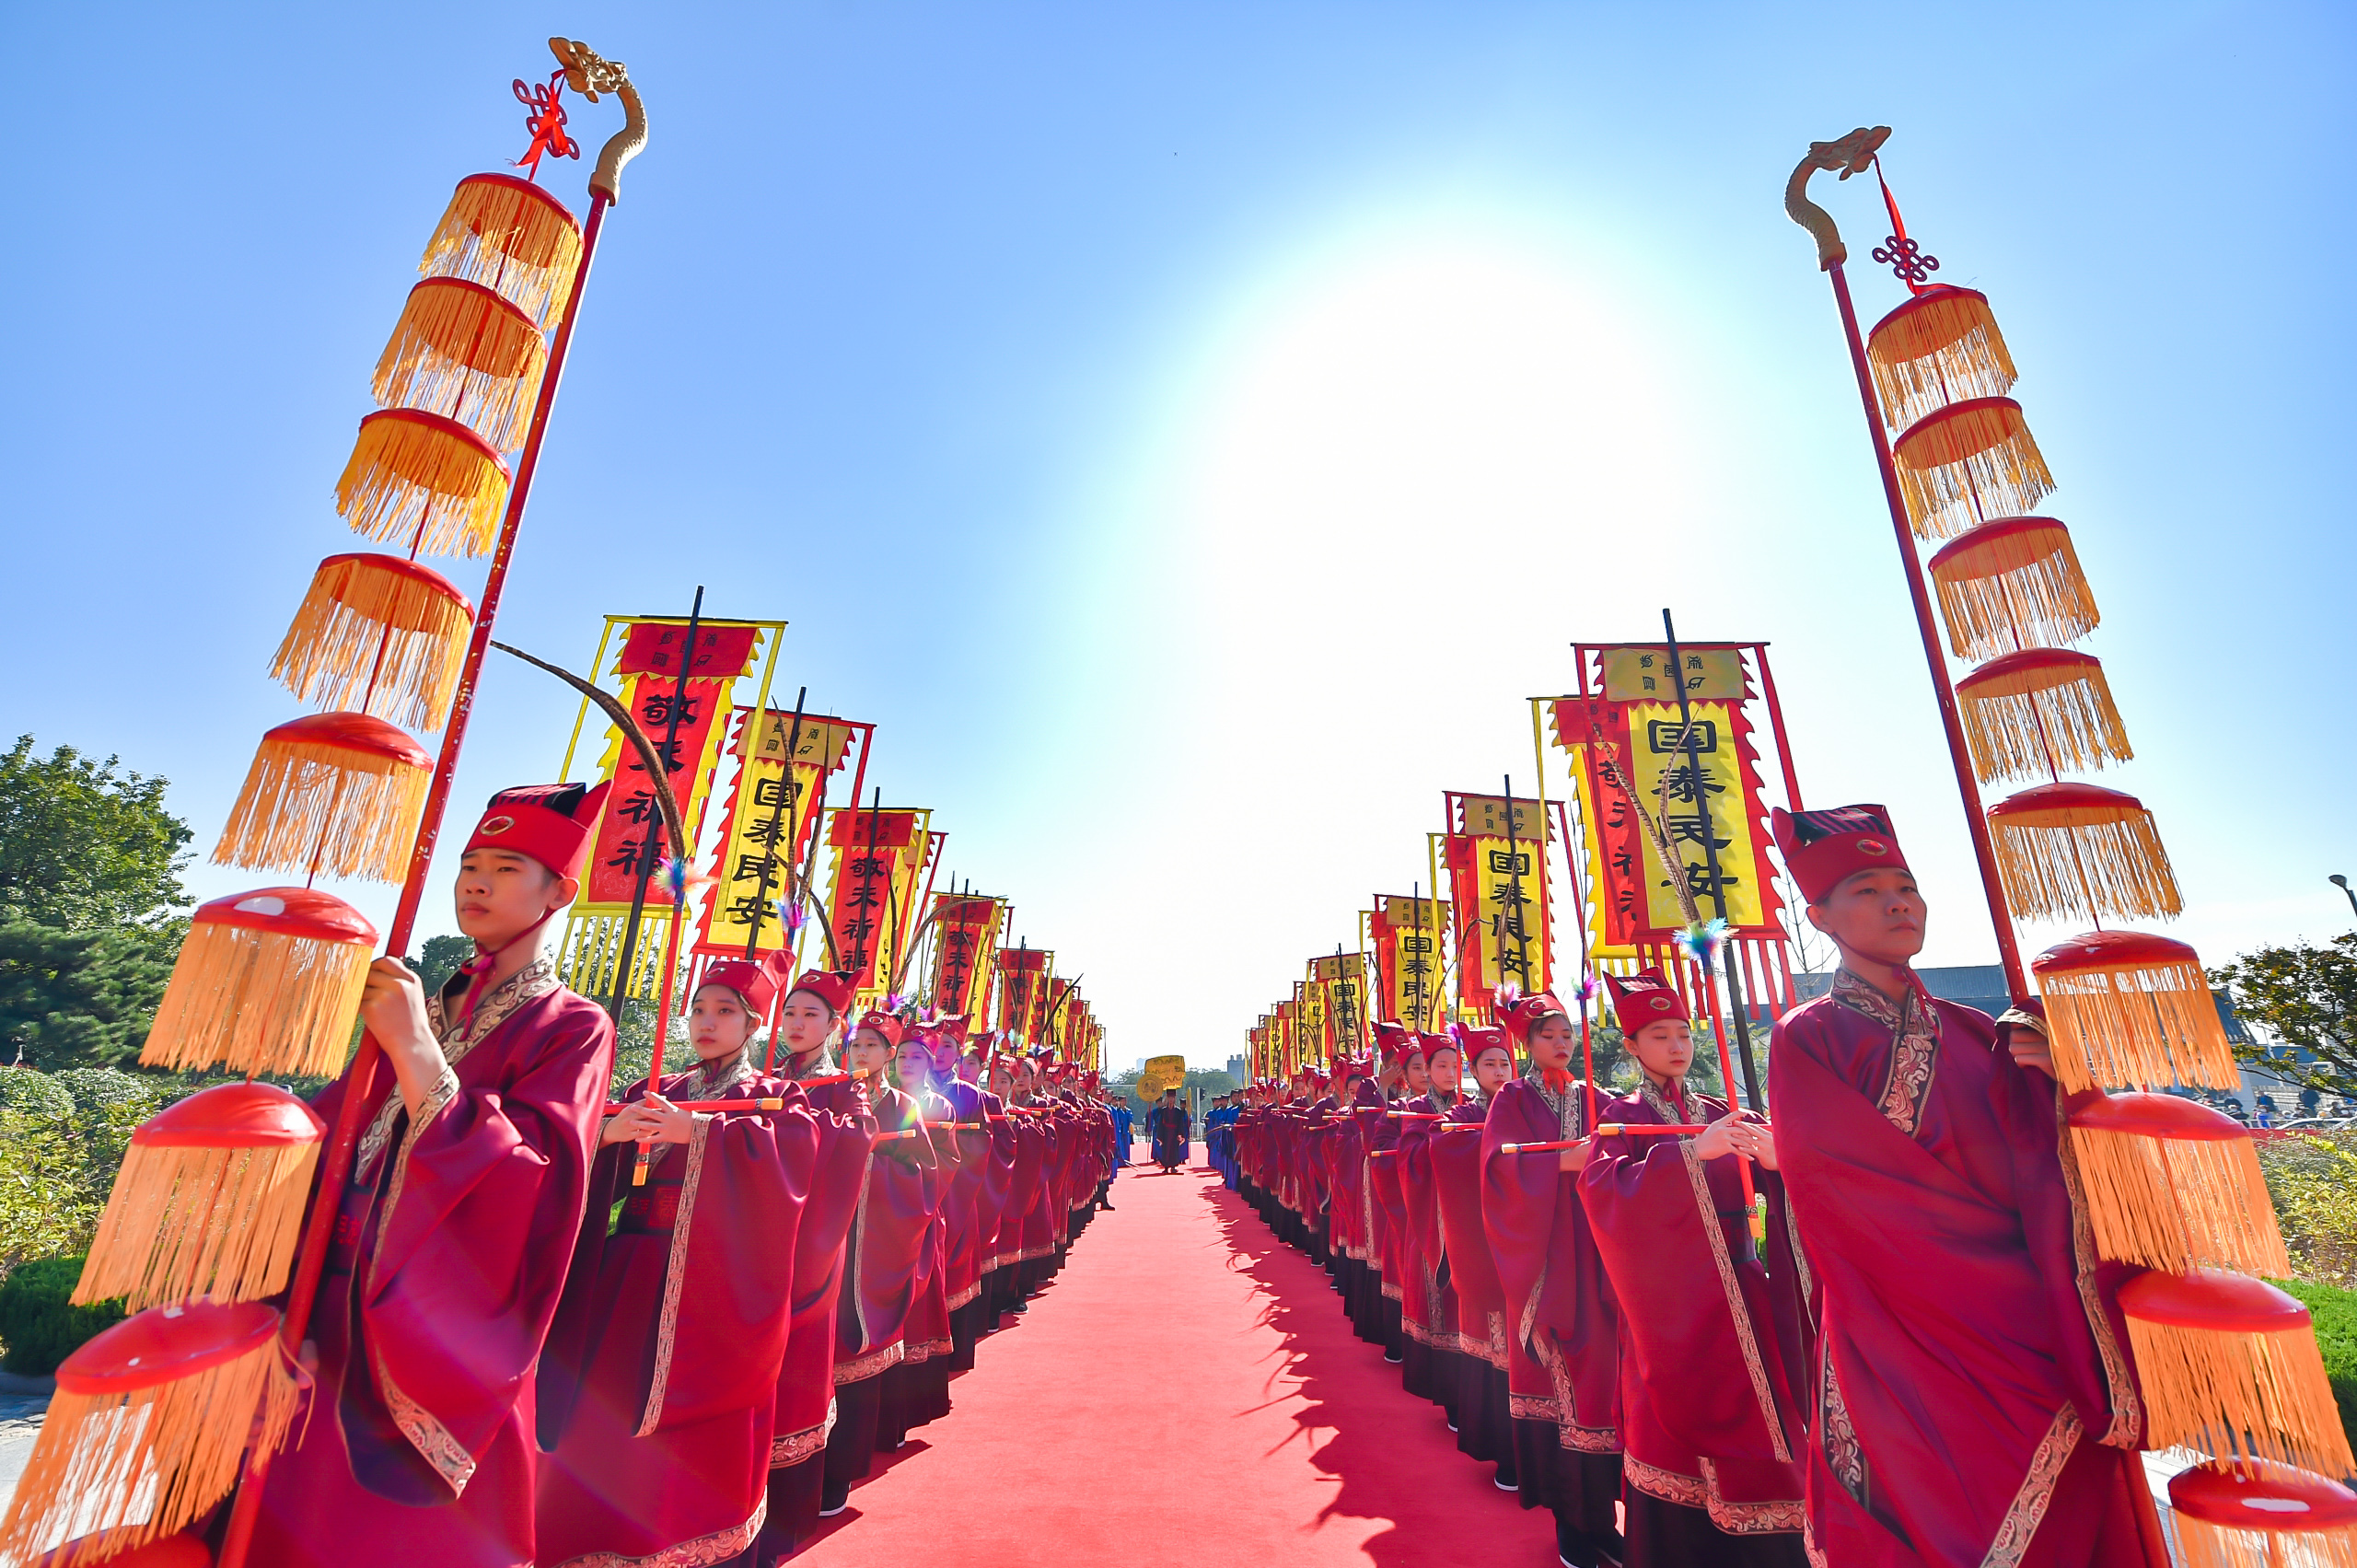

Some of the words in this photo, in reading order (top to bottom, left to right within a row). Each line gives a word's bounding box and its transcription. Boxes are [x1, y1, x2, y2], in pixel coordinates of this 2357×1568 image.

[726, 777, 804, 929] 国泰民安
[1648, 719, 1738, 899] 国泰民安
[841, 857, 886, 972] 敬天祈福
[941, 930, 973, 1015] 敬天祈福
